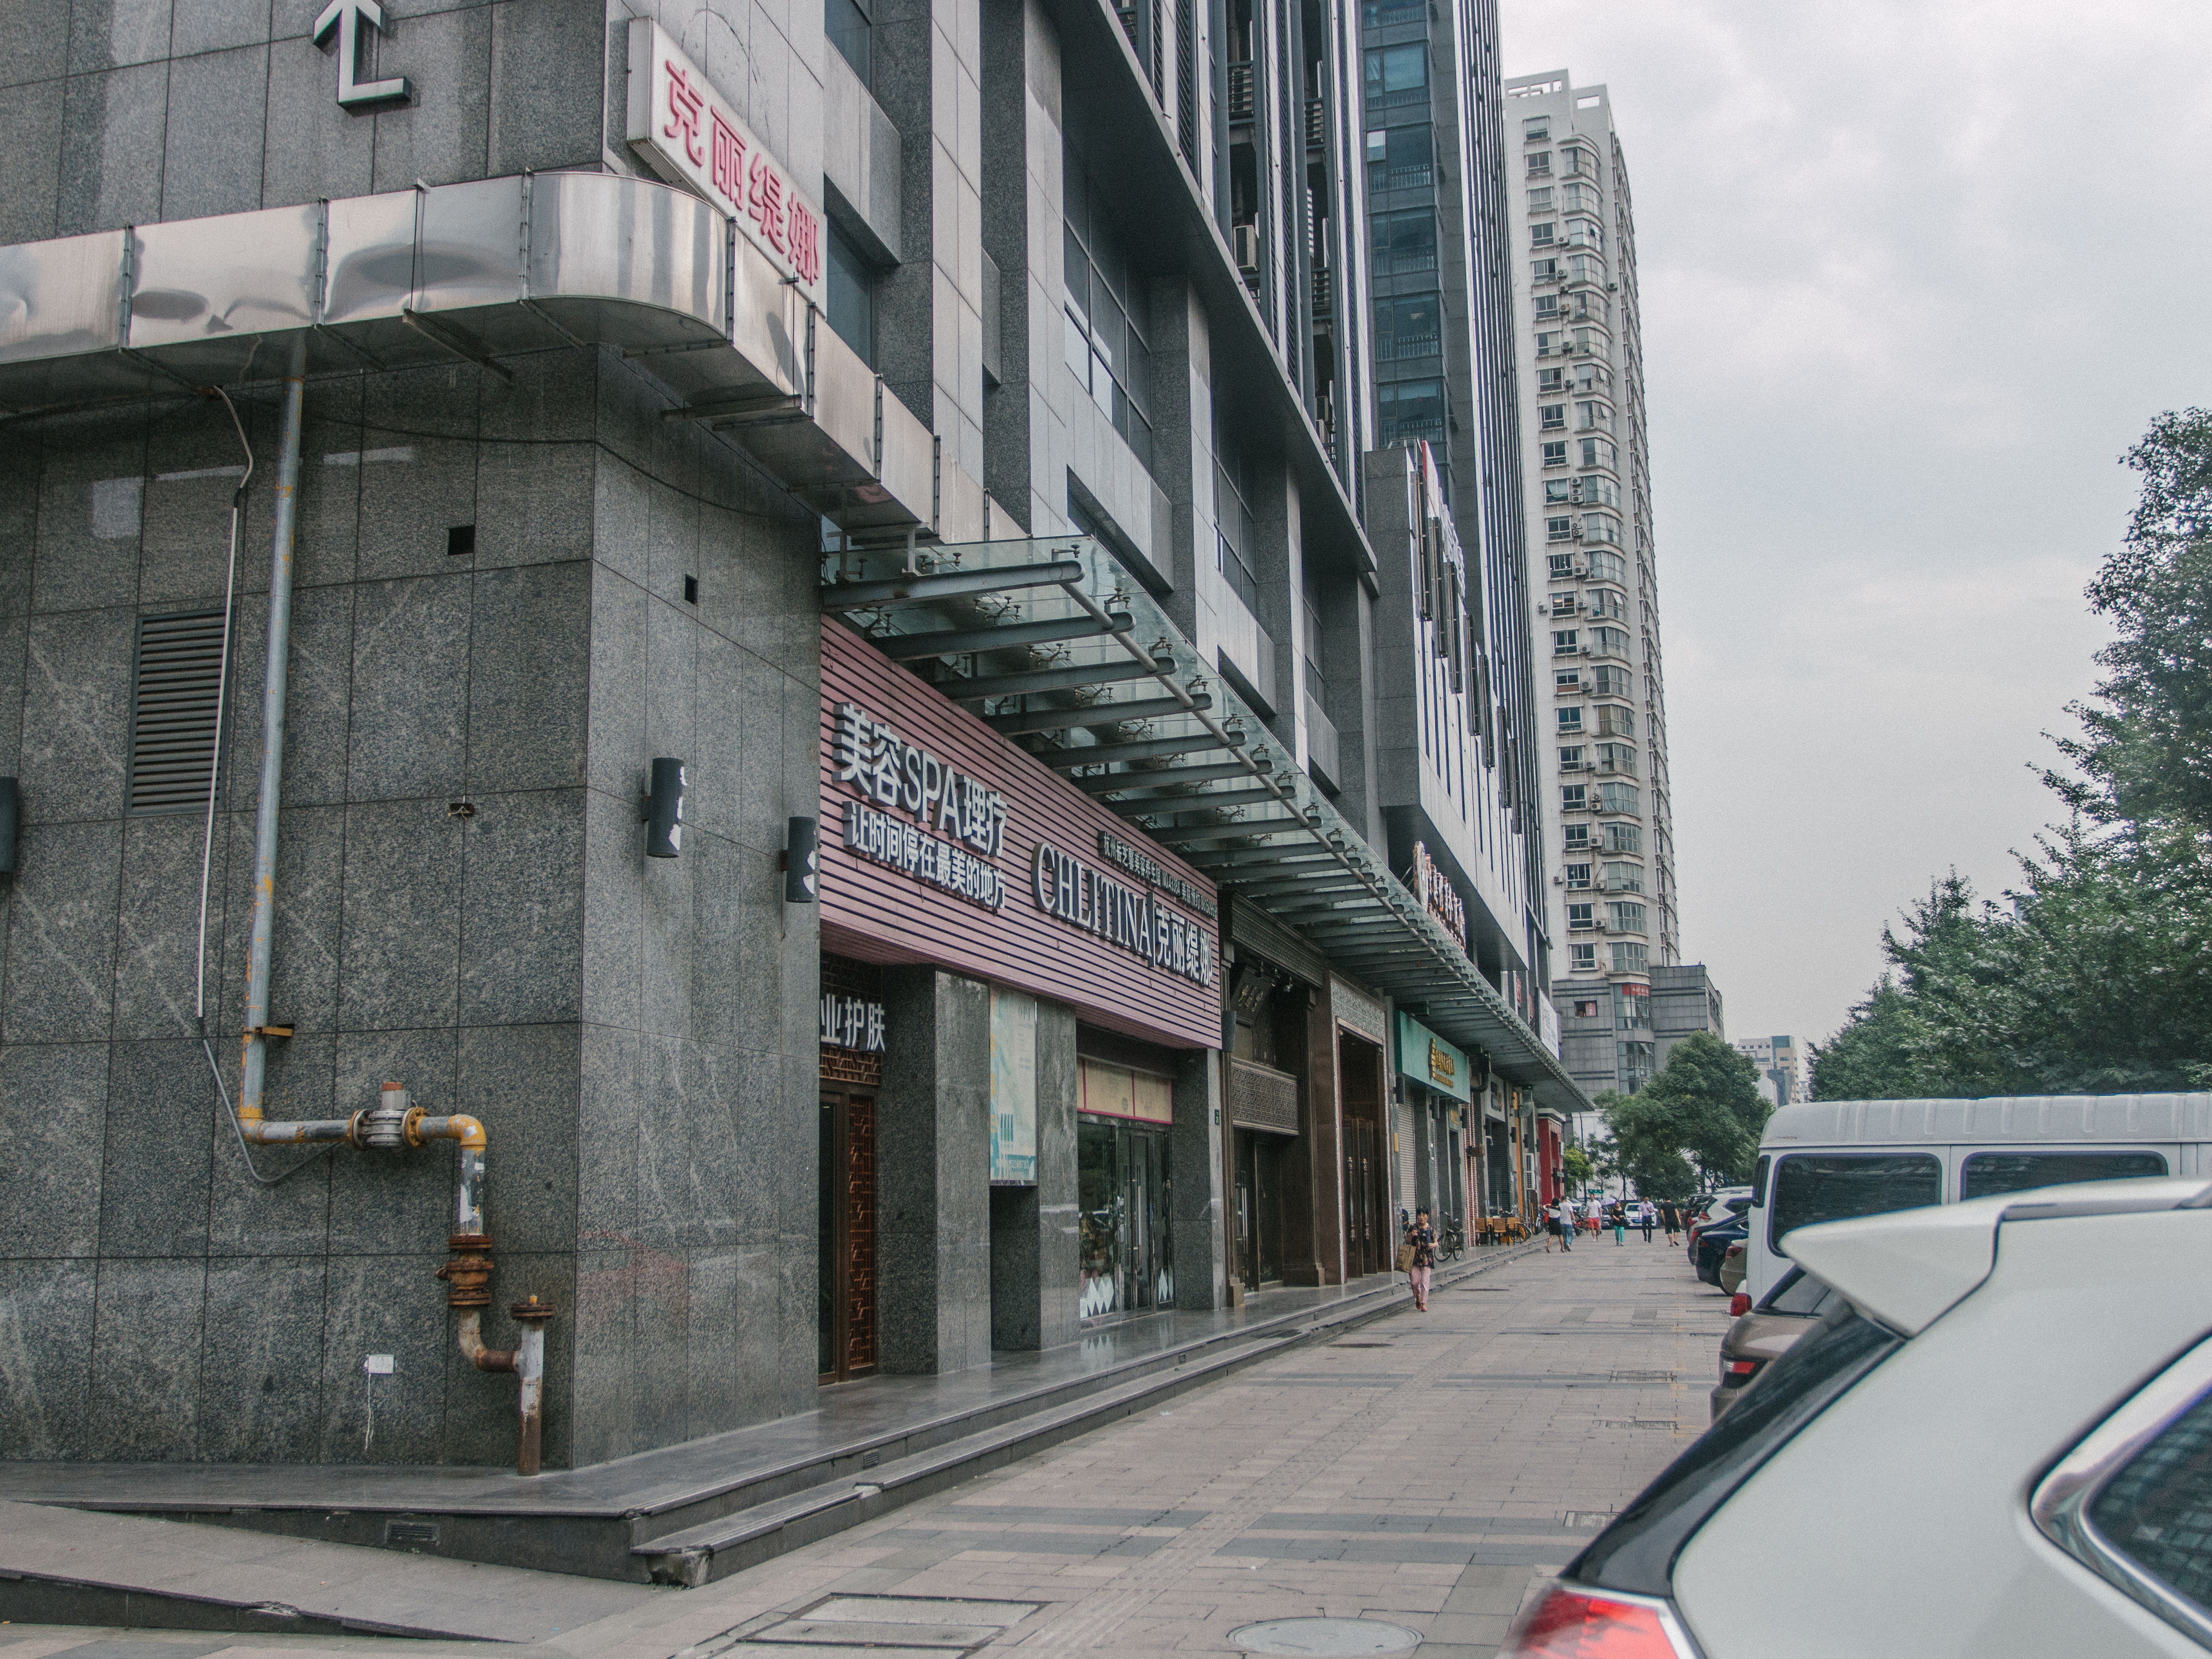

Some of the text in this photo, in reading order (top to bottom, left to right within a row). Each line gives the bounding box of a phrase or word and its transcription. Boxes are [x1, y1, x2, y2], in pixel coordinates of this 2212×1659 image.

[664, 60, 819, 286] 克丽缇娜
[838, 703, 1007, 857] 美容SPA理疗
[850, 801, 1006, 909] 让时间停在最美的地方
[1037, 843, 1213, 986] CHLITINA 克丽缇娜
[820, 993, 886, 1053] 业护肤
